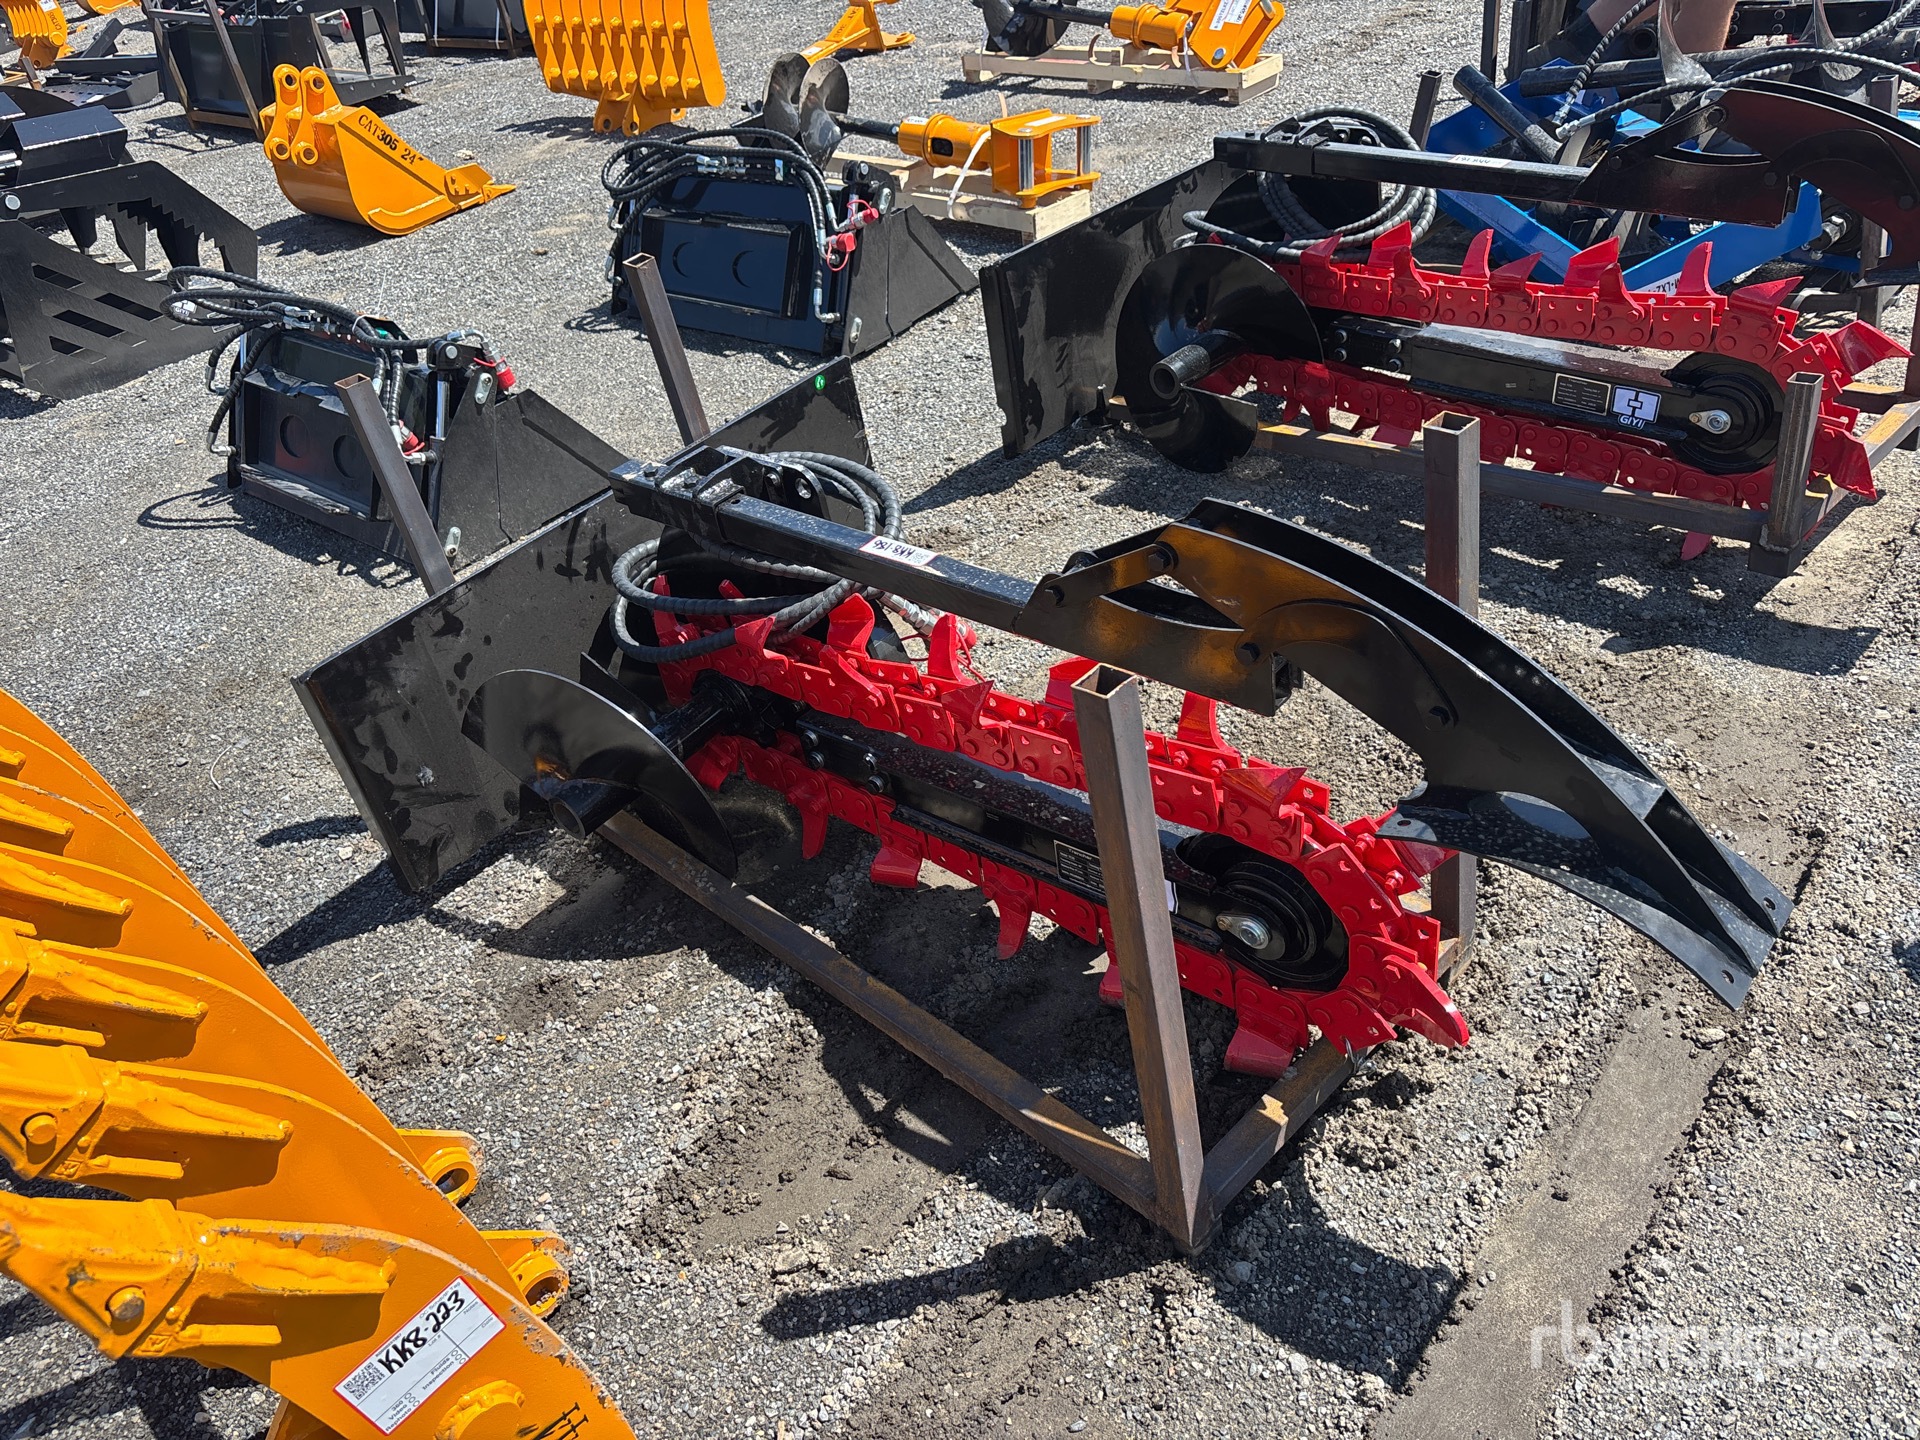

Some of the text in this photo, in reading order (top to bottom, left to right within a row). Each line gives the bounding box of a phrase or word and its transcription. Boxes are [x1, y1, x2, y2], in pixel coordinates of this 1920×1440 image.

[358, 114, 399, 151] CAT305
[1619, 415, 1645, 428] GIYI
[463, 1300, 479, 1315] Notes
[481, 1316, 494, 1329] Date
[377, 1289, 466, 1375] KK8-223
[422, 1361, 455, 1390] Inspection
[430, 1357, 451, 1376] Fluids
[388, 1403, 408, 1421] Video
[391, 1400, 404, 1412] 360
[385, 1407, 412, 1432] Rephoto
